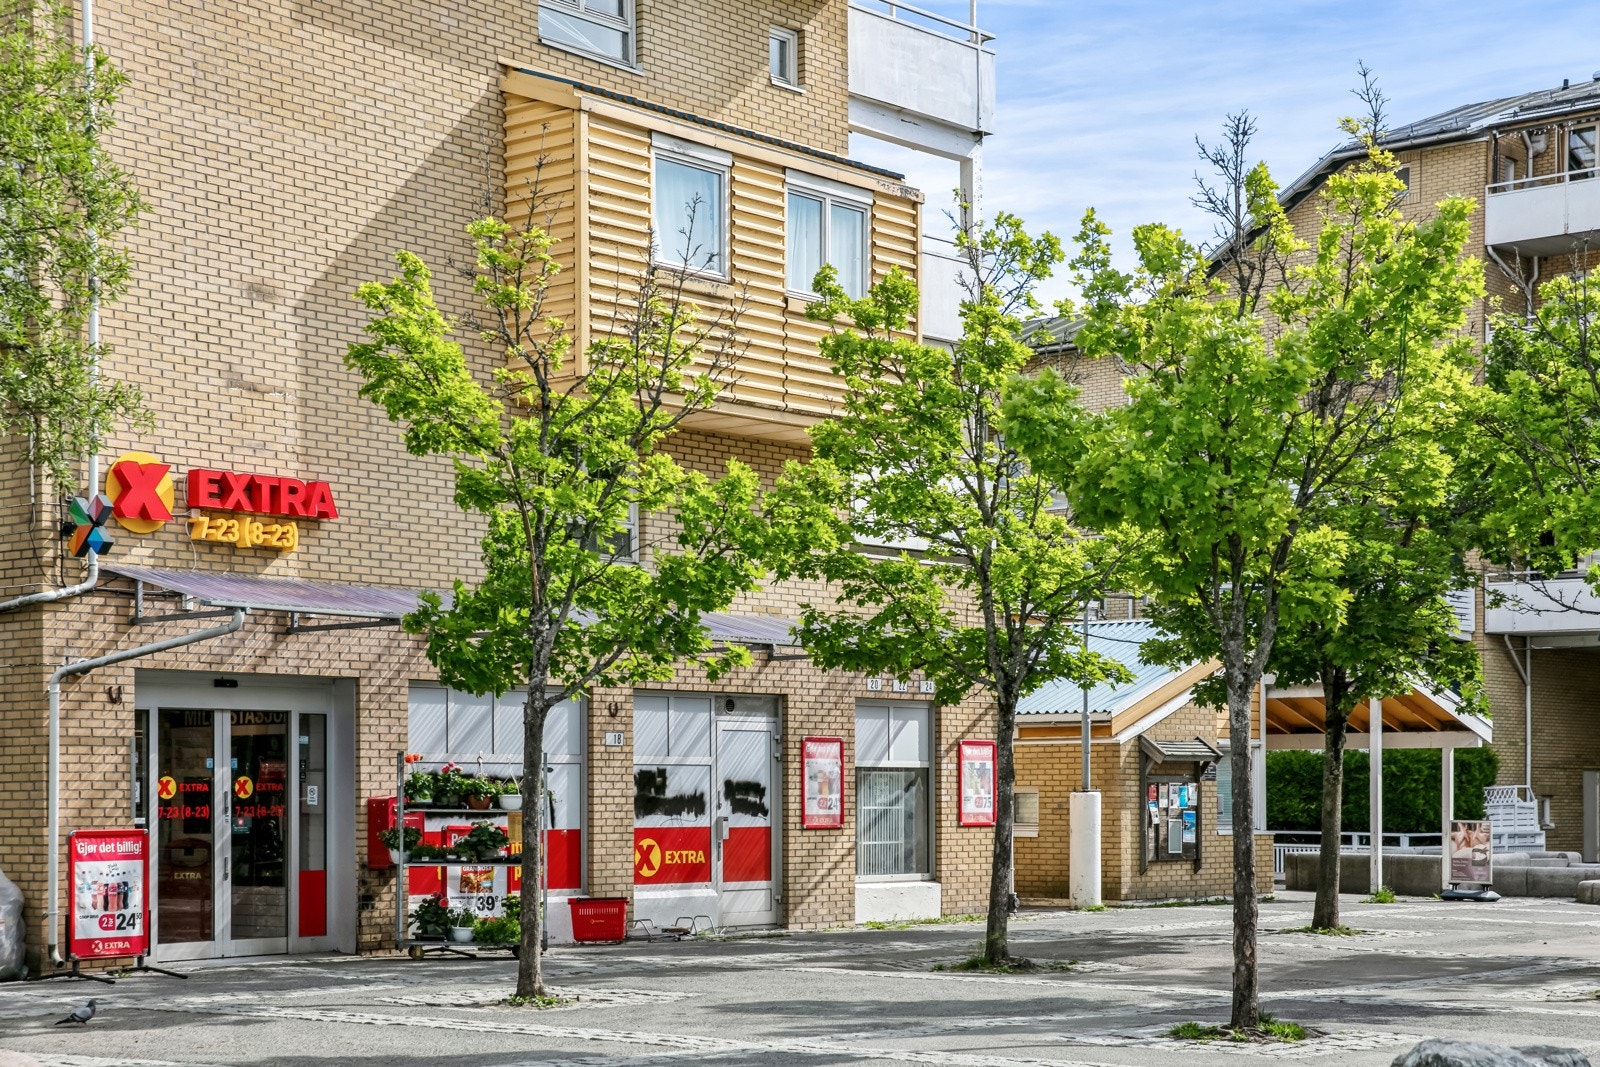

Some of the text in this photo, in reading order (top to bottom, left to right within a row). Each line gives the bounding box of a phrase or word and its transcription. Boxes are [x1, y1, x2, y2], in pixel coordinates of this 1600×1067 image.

[188, 469, 338, 519] EXTRA
[190, 516, 298, 552] 7-23 (8-23)
[871, 680, 878, 690] 20
[926, 682, 932, 691] 24
[614, 734, 622, 744] 18
[179, 783, 208, 792] EXTRA
[256, 782, 284, 792] EXTRA
[158, 806, 178, 819] 7-23
[181, 804, 210, 820] (8-23)
[235, 806, 255, 818] 7-23
[77, 840, 142, 856] Gjør det billig!
[665, 850, 706, 864] EXTRA
[174, 872, 202, 880] EXTRA
[476, 896, 496, 911] 39
[102, 918, 108, 928] 2
[116, 913, 136, 930] 24
[104, 942, 130, 950] EXTRA
